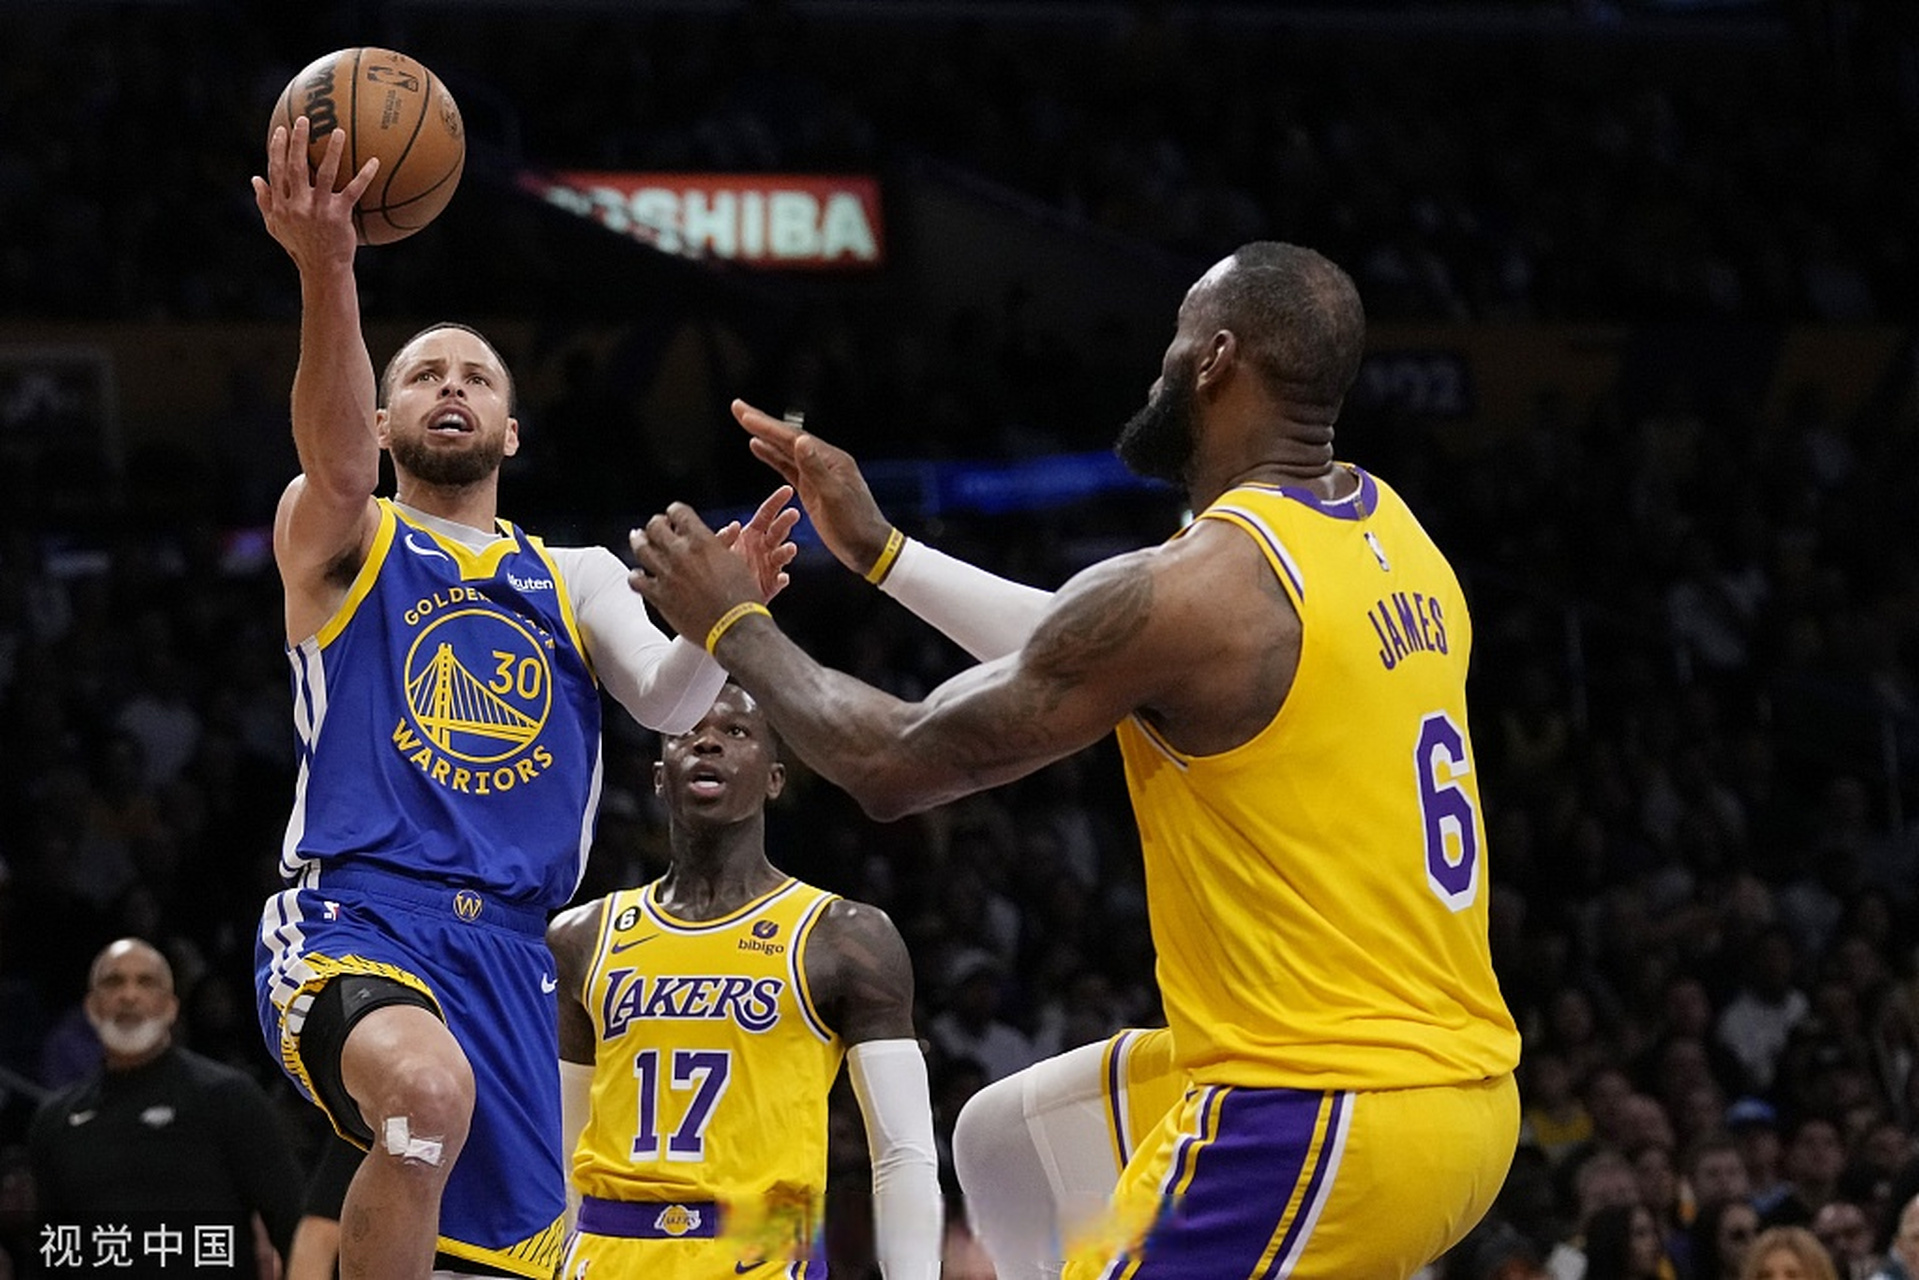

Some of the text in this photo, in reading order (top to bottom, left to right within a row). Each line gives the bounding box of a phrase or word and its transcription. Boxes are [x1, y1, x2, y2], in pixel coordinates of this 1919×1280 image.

[1367, 592, 1449, 671] JAMES
[488, 650, 542, 700] 30
[391, 717, 554, 795] WARRIORS
[1414, 709, 1480, 914] 6
[617, 908, 637, 931] 6
[738, 938, 785, 957] bibigo
[602, 968, 787, 1041] LAKERS
[629, 1048, 732, 1163] 17
